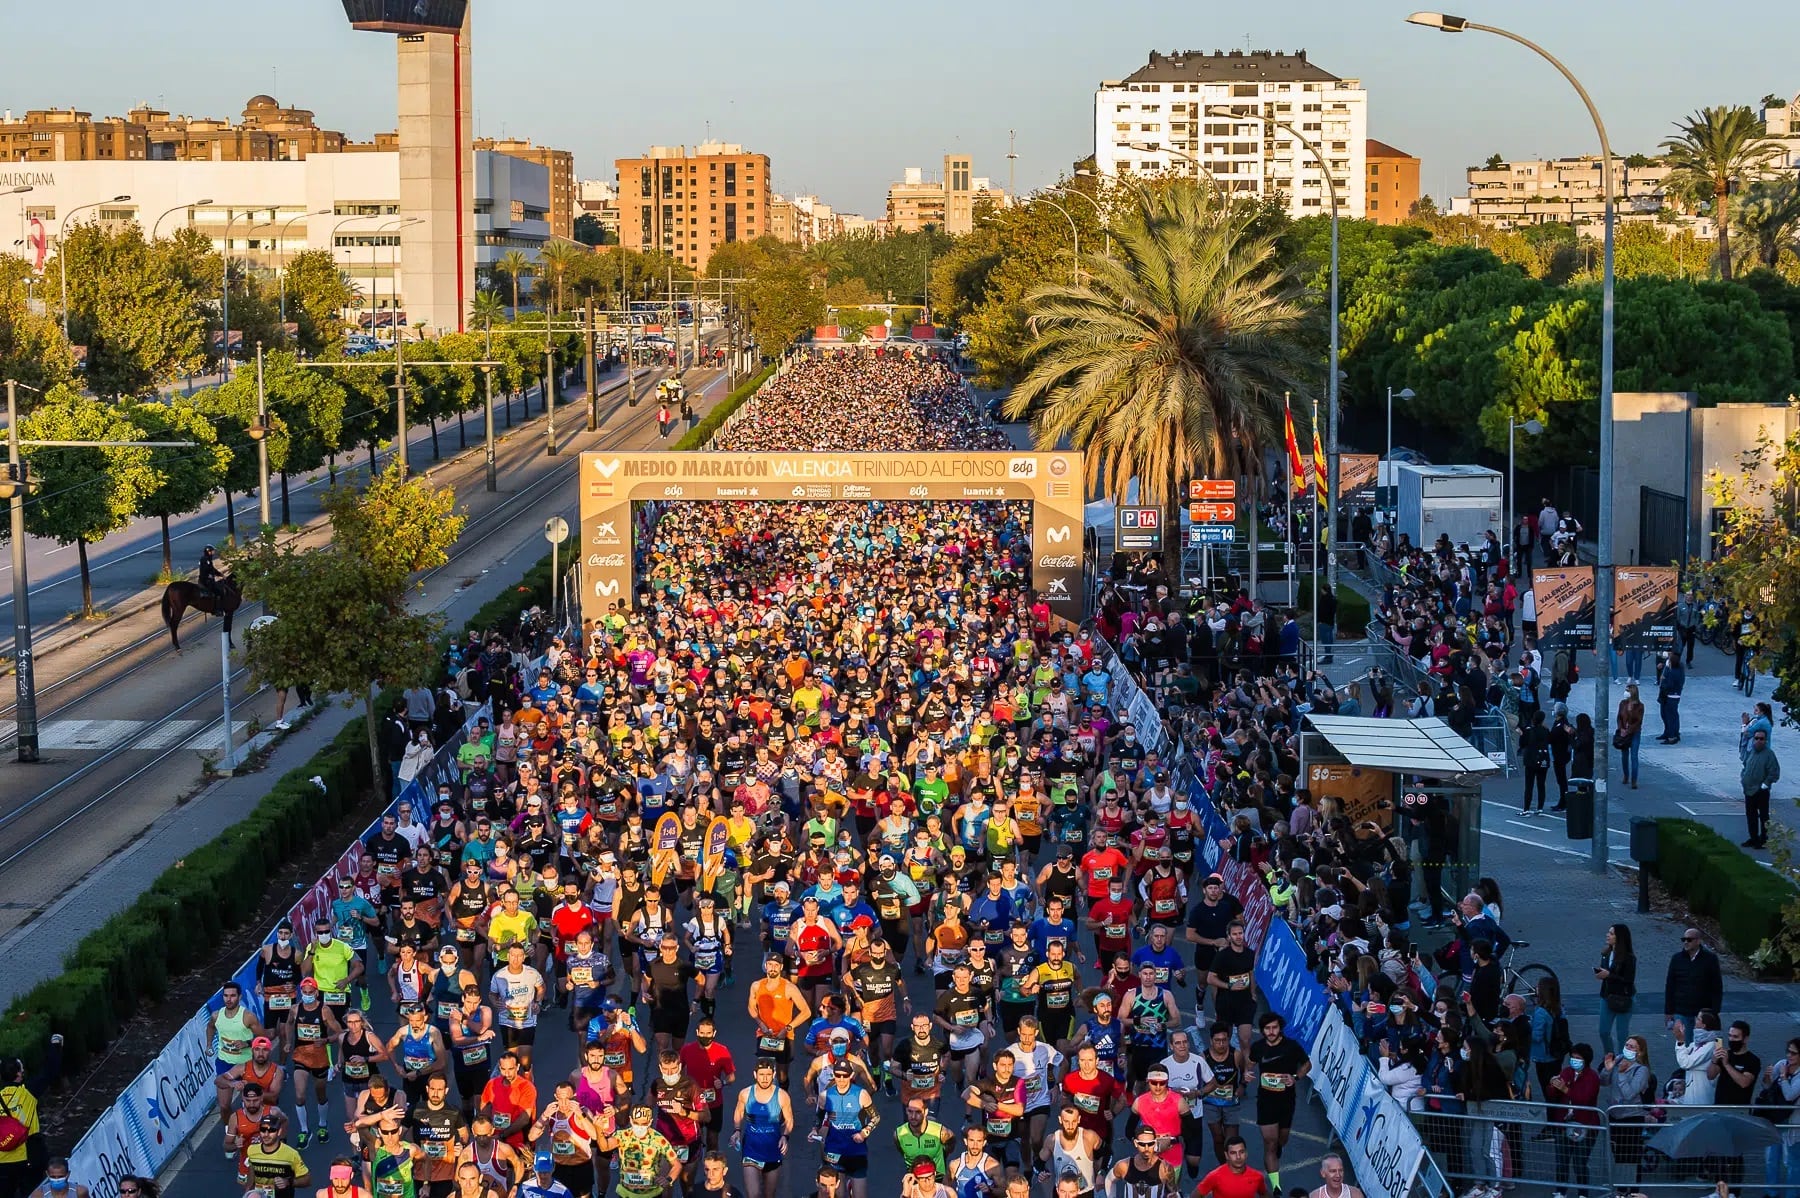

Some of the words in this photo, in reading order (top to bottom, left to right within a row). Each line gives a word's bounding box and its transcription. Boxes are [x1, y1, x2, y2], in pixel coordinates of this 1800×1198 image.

[623, 460, 677, 477] MEDIO
[693, 456, 768, 477] MARATÓN
[770, 459, 853, 477] VALENCIA
[852, 460, 928, 477] TRINIDAD
[930, 460, 1006, 477] ALFONSO
[1012, 460, 1034, 477] edp
[664, 483, 683, 497] edp
[909, 483, 929, 497] edp
[1126, 512, 1135, 526] P
[1141, 512, 1156, 526] 1A
[1221, 528, 1233, 541] 14
[1556, 578, 1593, 604] VELOCIDAD
[1636, 579, 1675, 604] VELOCITAT
[1311, 768, 1330, 781] 30
[662, 826, 676, 836] 1:45
[712, 830, 726, 841] 1:45
